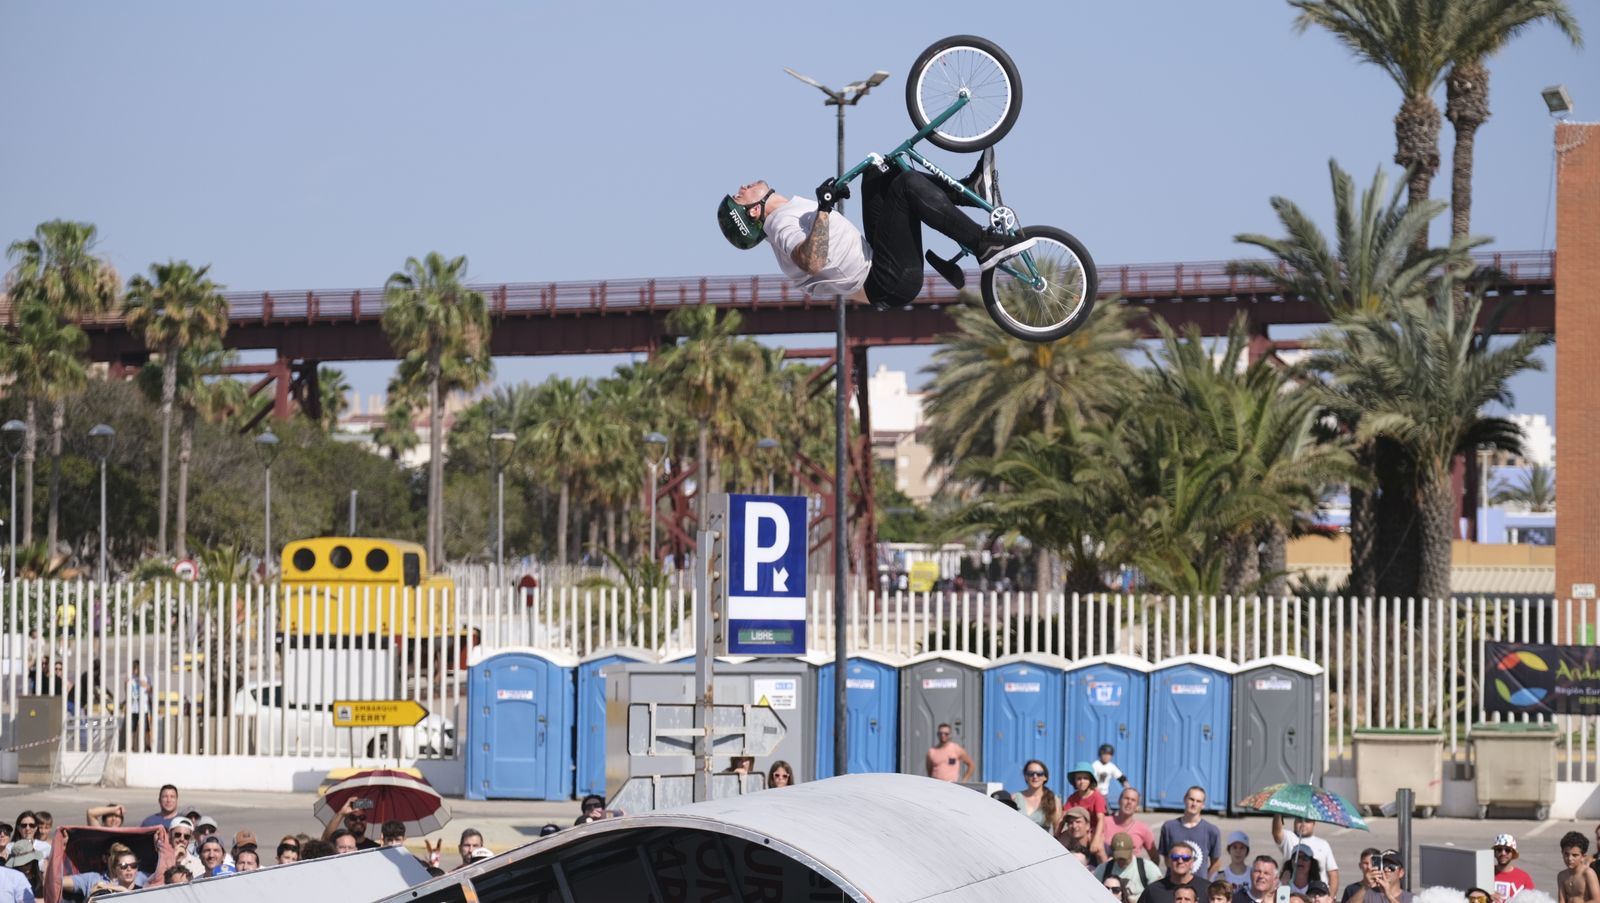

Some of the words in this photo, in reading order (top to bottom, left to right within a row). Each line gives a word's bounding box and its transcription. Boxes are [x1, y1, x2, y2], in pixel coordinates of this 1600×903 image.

[922, 158, 965, 193] CANNA
[729, 209, 748, 236] CANNA
[744, 501, 790, 591] P
[750, 630, 774, 640] LIBRE
[1554, 686, 1584, 696] Región
[1269, 799, 1307, 812] Desigual
